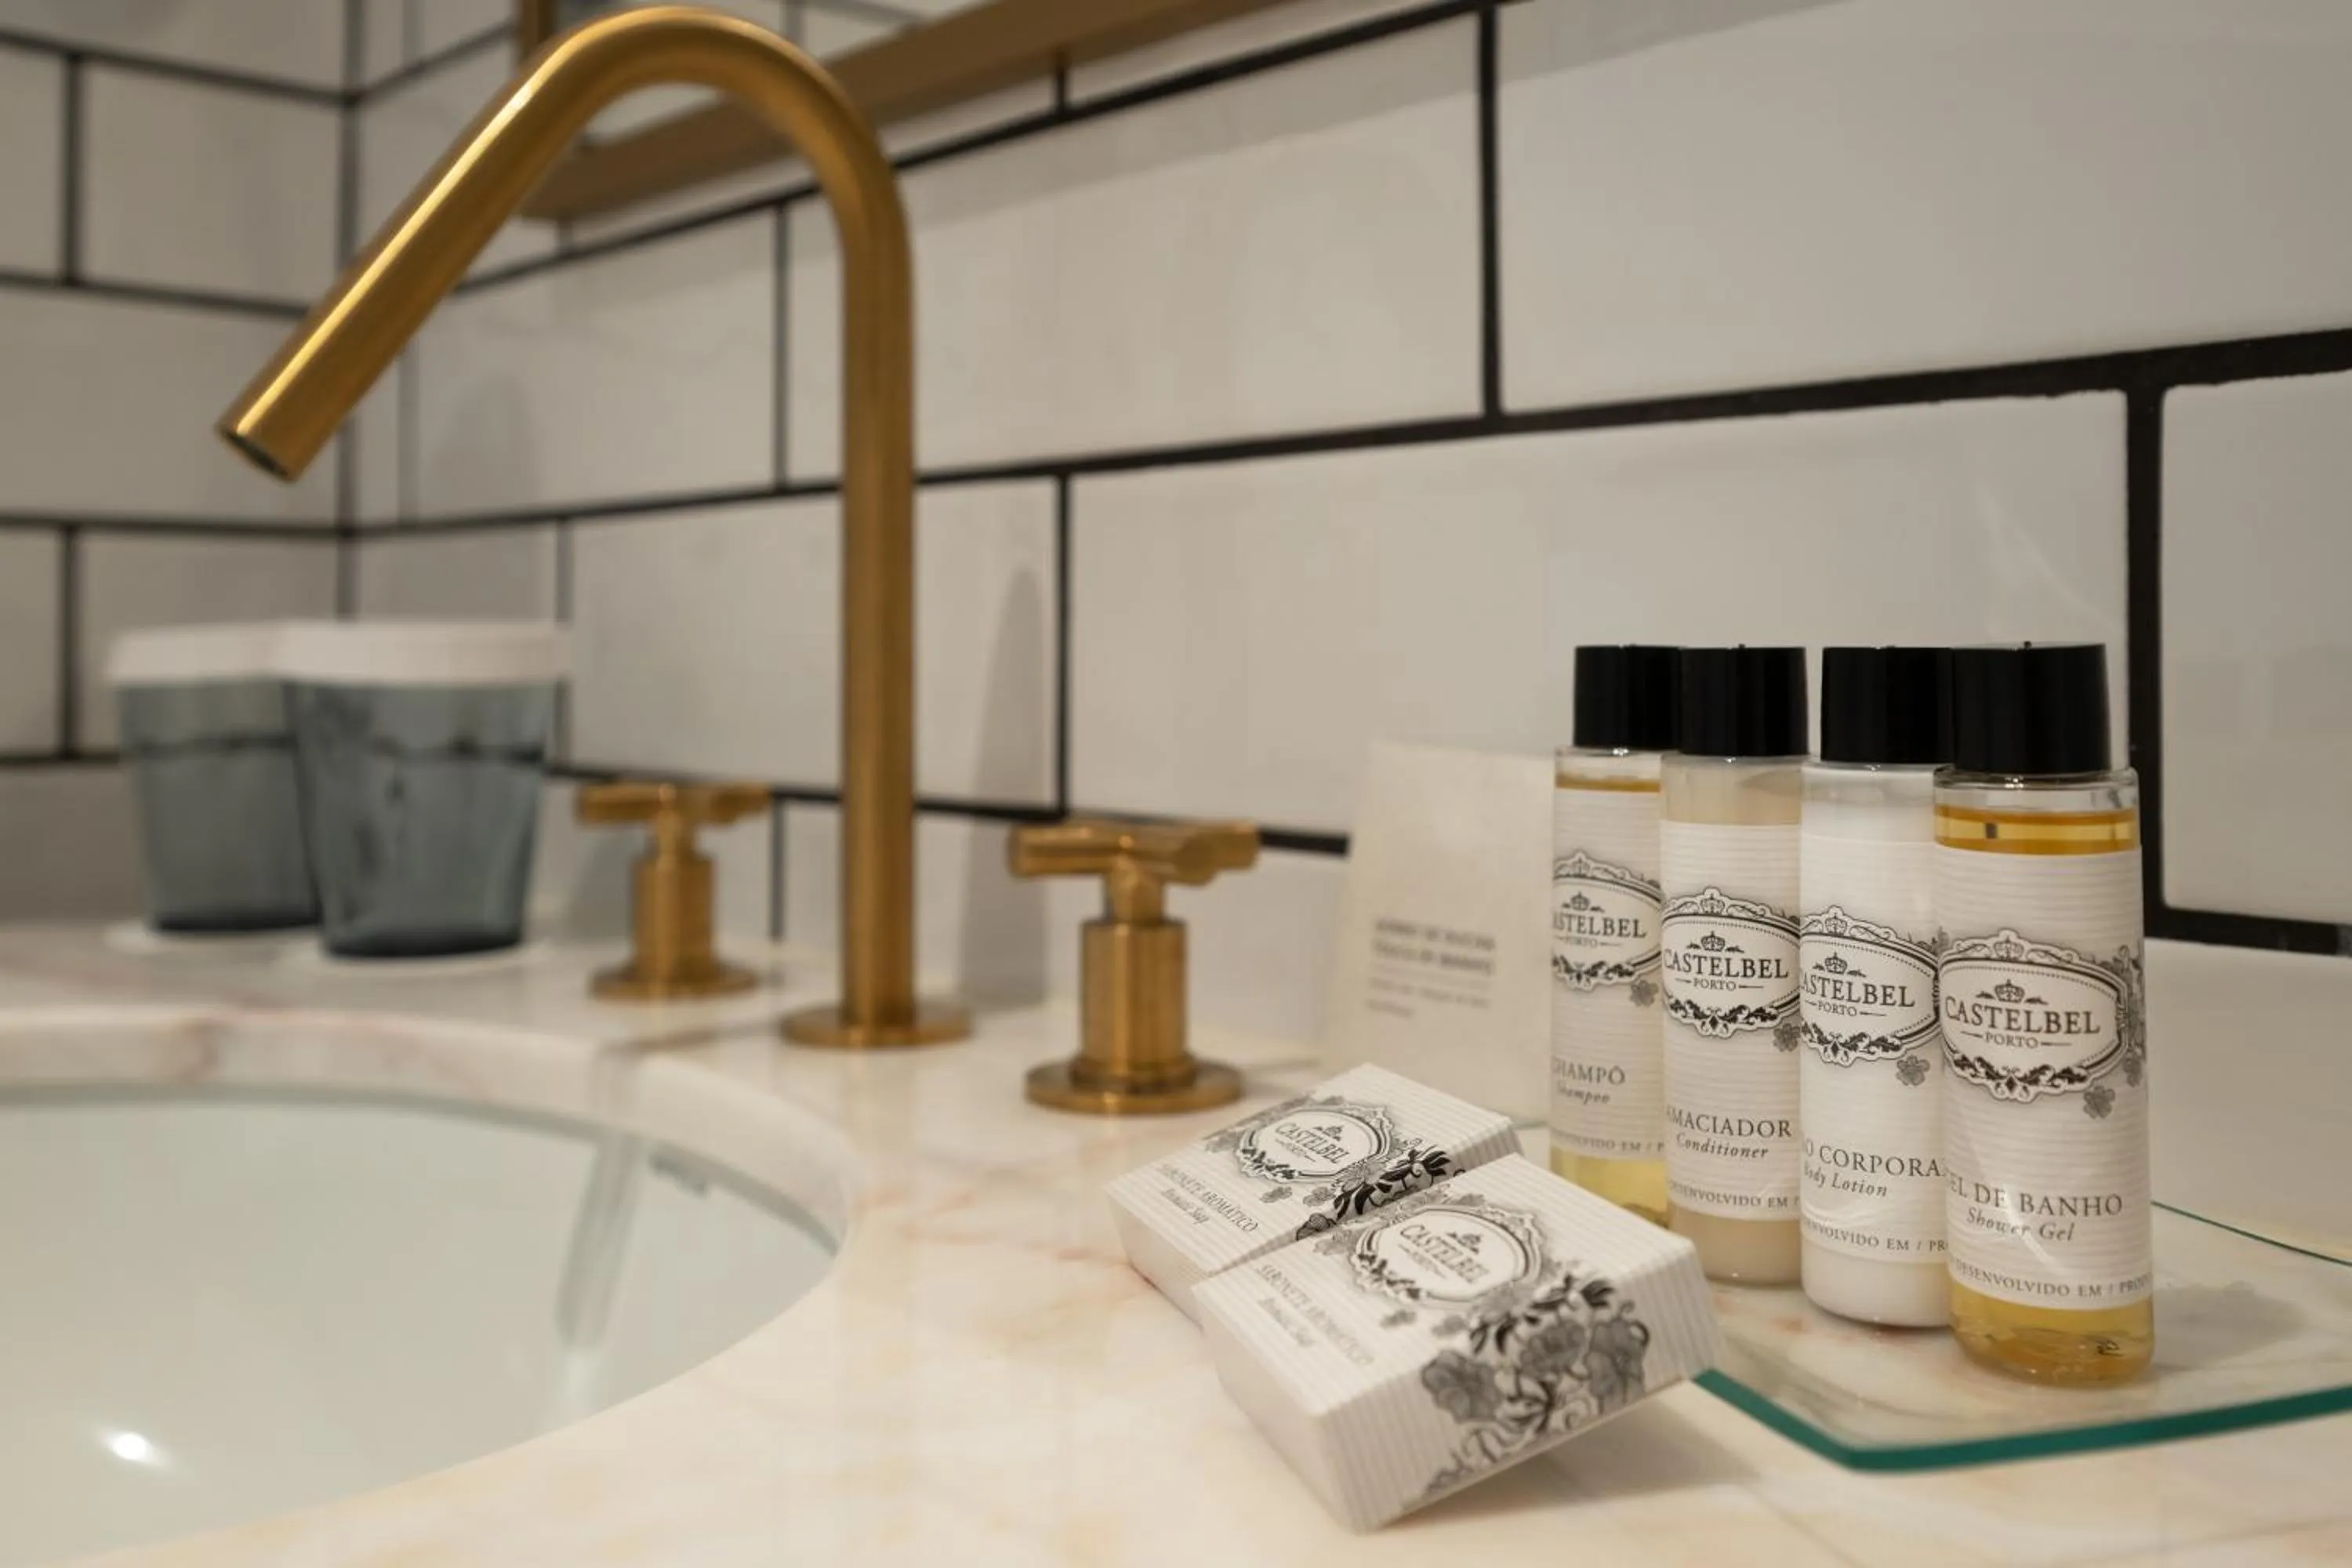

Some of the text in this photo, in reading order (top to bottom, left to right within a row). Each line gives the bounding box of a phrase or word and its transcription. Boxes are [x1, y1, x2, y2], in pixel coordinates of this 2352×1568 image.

[1664, 948, 1789, 978] CASTELBEL
[1693, 978, 1737, 991] PORTO
[1802, 972, 1915, 1007] ASTELBEL
[1818, 1000, 1858, 1017] PORTO
[1945, 996, 2101, 1035] CASTELBEL
[1985, 1032, 2039, 1049] PORTO
[1553, 1058, 1626, 1086] HAMPÔ
[1275, 1123, 1350, 1164] CASTELBEL
[1676, 1132, 1769, 1159] Conditioner
[1819, 1145, 1946, 1178] CORPORA
[1831, 1173, 1888, 1197] Lotion
[1974, 1182, 2006, 1208] DE
[2019, 1192, 2123, 1218] BANHO
[1966, 1206, 2076, 1241] Shower Gel
[1886, 1237, 1909, 1251] EM
[1929, 1239, 1948, 1252] PR
[2078, 1284, 2103, 1298] EM
